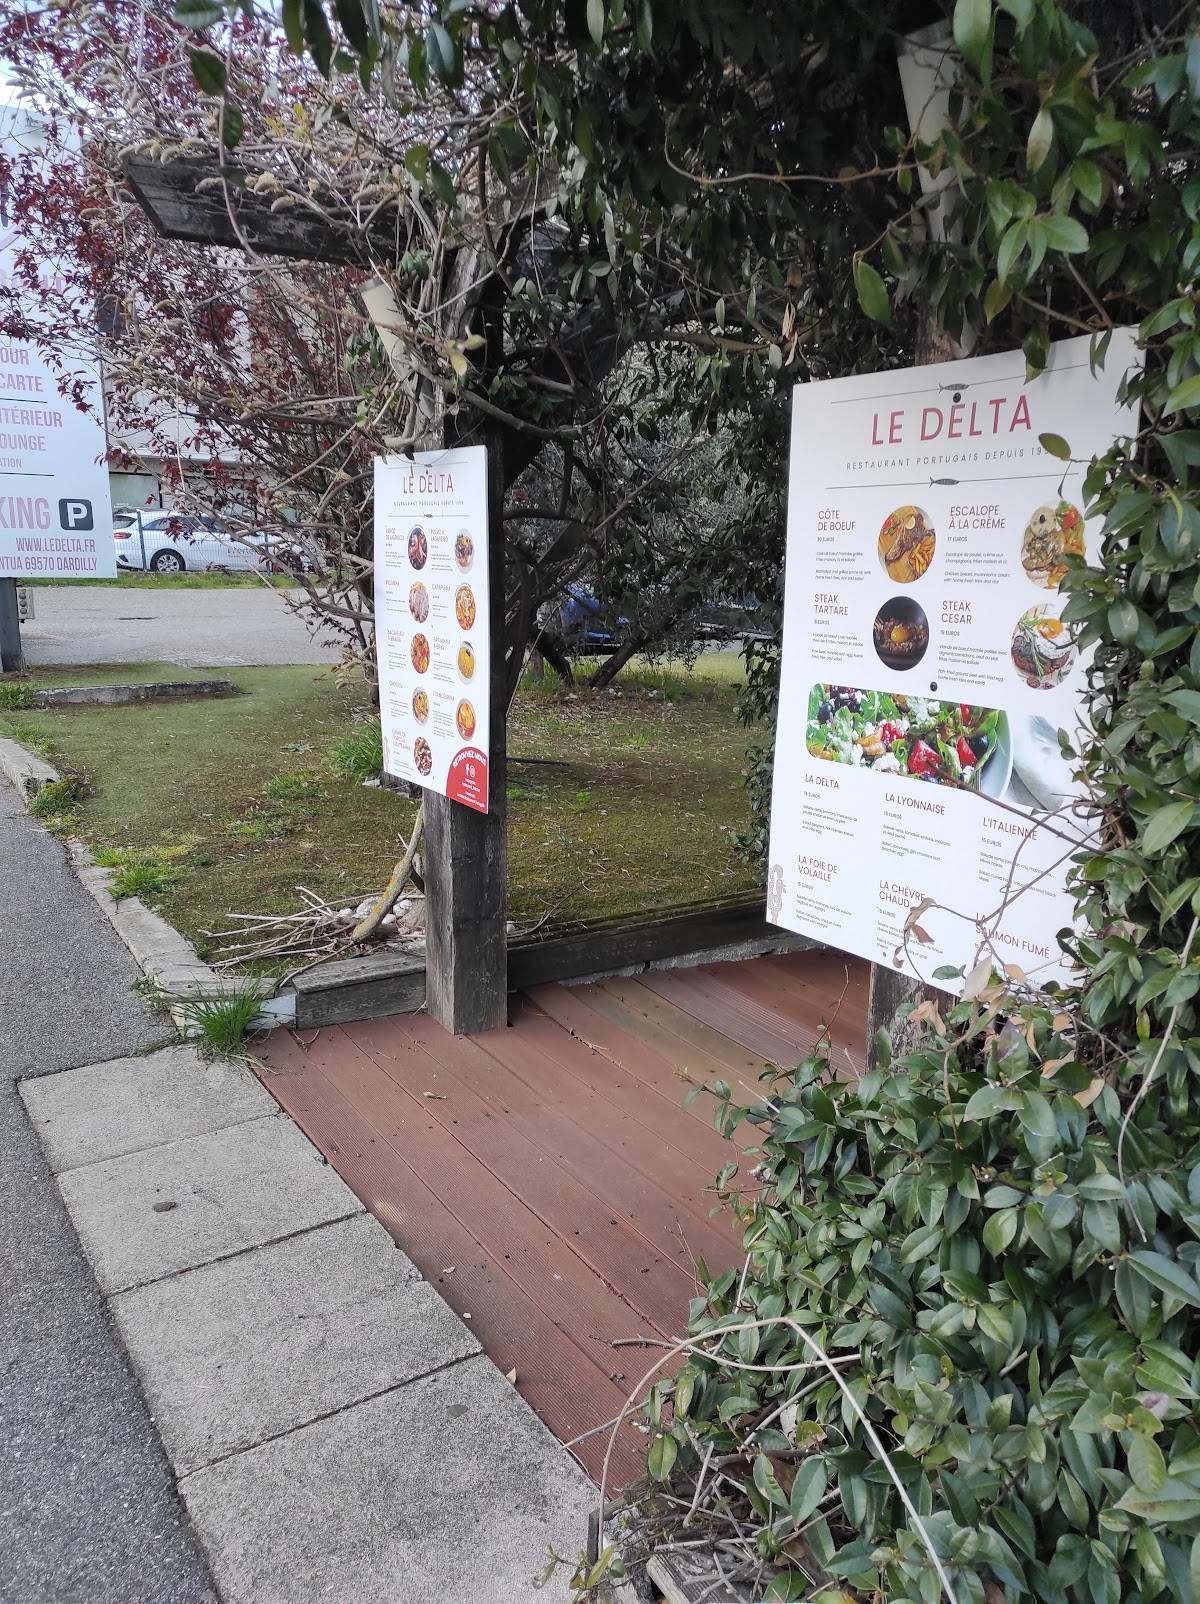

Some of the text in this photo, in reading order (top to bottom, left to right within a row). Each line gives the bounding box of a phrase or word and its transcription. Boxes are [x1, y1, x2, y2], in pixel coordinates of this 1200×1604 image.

[0, 406, 62, 428] TÉRIEUR
[871, 394, 1032, 446] LE DELTA
[846, 458, 910, 472] RESTAURANT
[916, 452, 978, 466] PORTUGAIS
[985, 448, 1025, 461] DEPUIS
[403, 473, 454, 494] LE DELTA
[66, 502, 88, 528] P
[818, 508, 840, 520] CÔTE
[950, 504, 1000, 517] ESCALOPE
[817, 521, 856, 531] DE BOEUF
[949, 517, 1006, 530] À LA CRÈME
[16, 537, 96, 553] WWW.LEDELTA.FR
[25, 556, 55, 571] 69570
[57, 557, 97, 571] DARDILLY
[814, 593, 838, 604] STEAK
[942, 600, 971, 612] STEAK
[814, 604, 849, 616] TARTARE
[941, 612, 972, 625] CESAR
[804, 773, 839, 790] LA DELTA
[885, 792, 946, 816] LA LYONNAISE
[982, 817, 1038, 841] L'ITALIENNE
[798, 854, 838, 874] LA FOIE DE
[798, 865, 831, 882] VOLAILLE
[879, 880, 925, 902] LA CHÈVRE
[879, 891, 910, 908] CHAUD
[1022, 941, 1051, 959] FUMÉ
